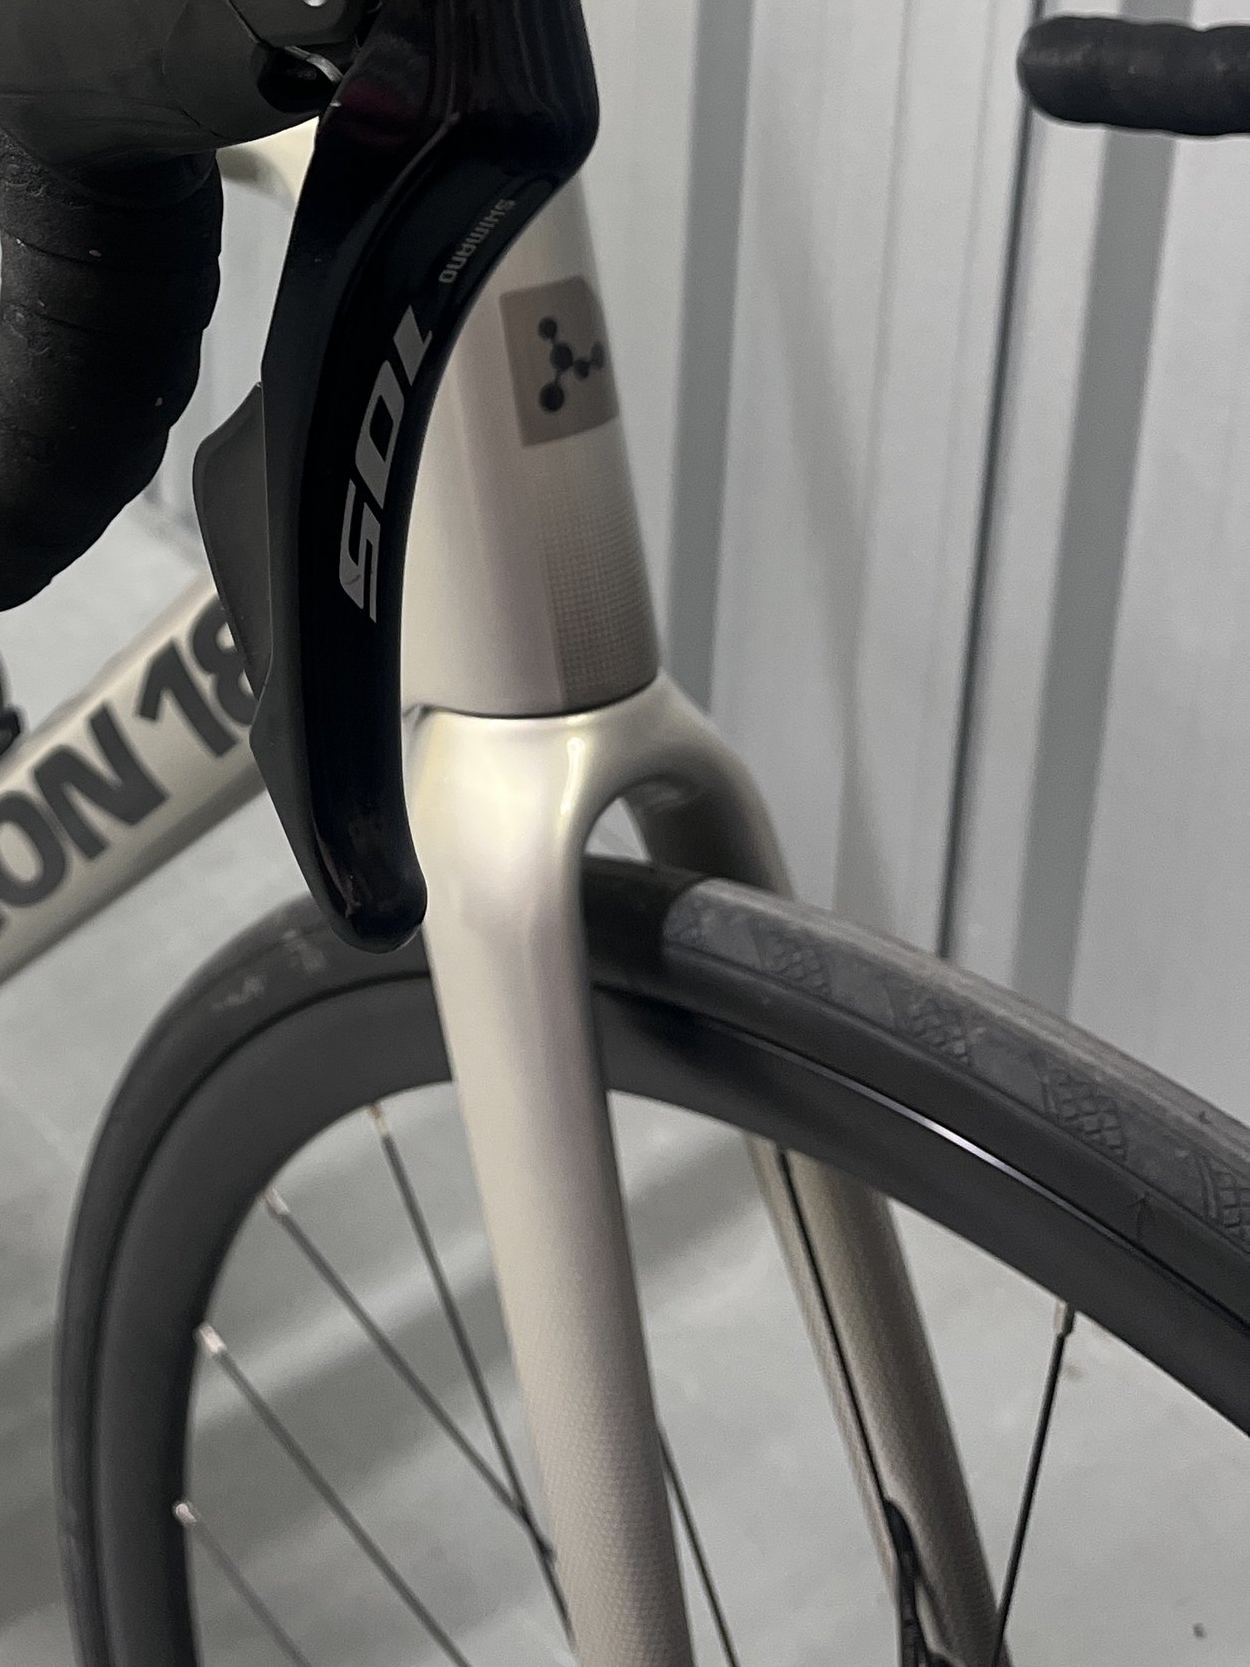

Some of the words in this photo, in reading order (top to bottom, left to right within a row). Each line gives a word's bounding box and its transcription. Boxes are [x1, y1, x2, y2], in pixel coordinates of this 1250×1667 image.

[437, 198, 517, 285] SHIMANO
[338, 304, 434, 625] 105
[134, 595, 261, 760] 18
